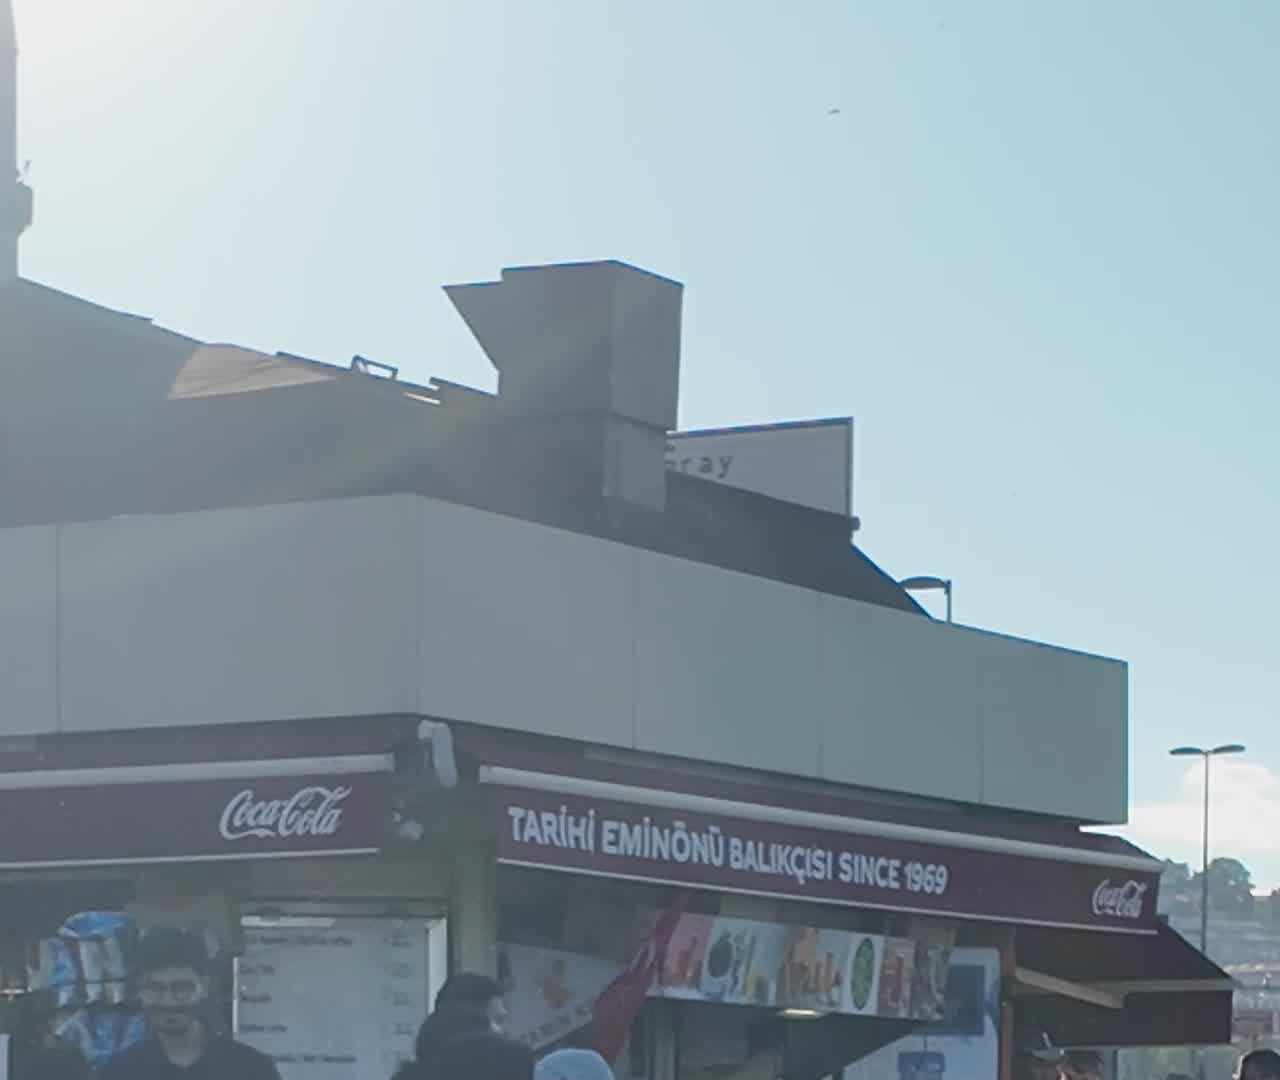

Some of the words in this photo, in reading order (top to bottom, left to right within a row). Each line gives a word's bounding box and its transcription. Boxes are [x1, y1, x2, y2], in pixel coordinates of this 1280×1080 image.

[219, 786, 352, 840] Coca-Cola
[508, 805, 596, 852] TARİHİ
[602, 816, 724, 867] EMİNÖNÜ
[729, 838, 833, 884] BALIKÇISI
[839, 852, 901, 889] SINCE
[905, 862, 948, 895] 1969
[1092, 877, 1147, 918] Coca-Cola
